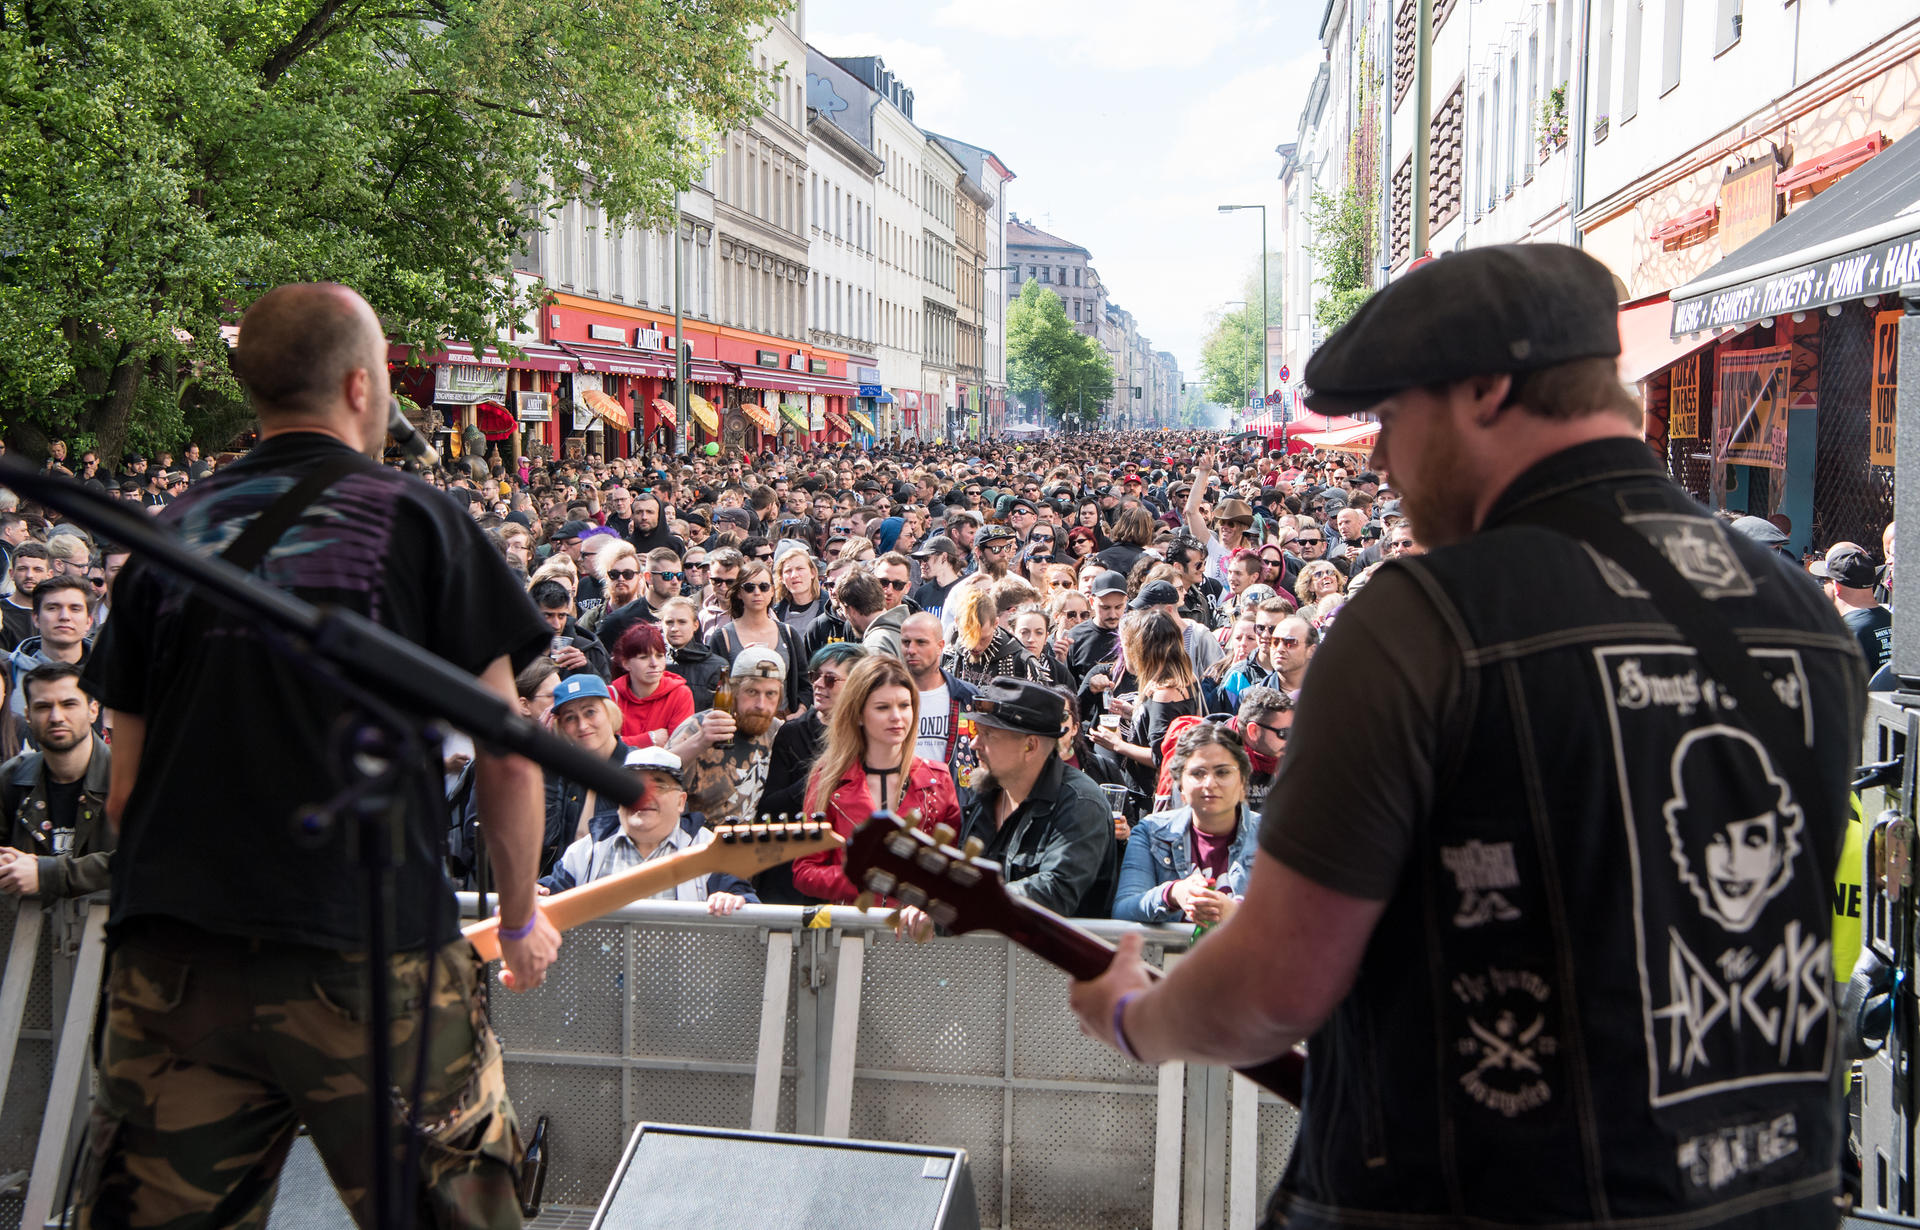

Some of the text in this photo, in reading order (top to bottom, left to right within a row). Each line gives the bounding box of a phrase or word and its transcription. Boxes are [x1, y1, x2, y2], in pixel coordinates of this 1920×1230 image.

[1675, 300, 1703, 333] MUSIC
[1708, 286, 1755, 326] T-SHIRTS
[1761, 269, 1816, 314] TICKETS
[1823, 254, 1872, 300] PUNK
[637, 322, 663, 351] AMRIT
[1254, 399, 1261, 408] P
